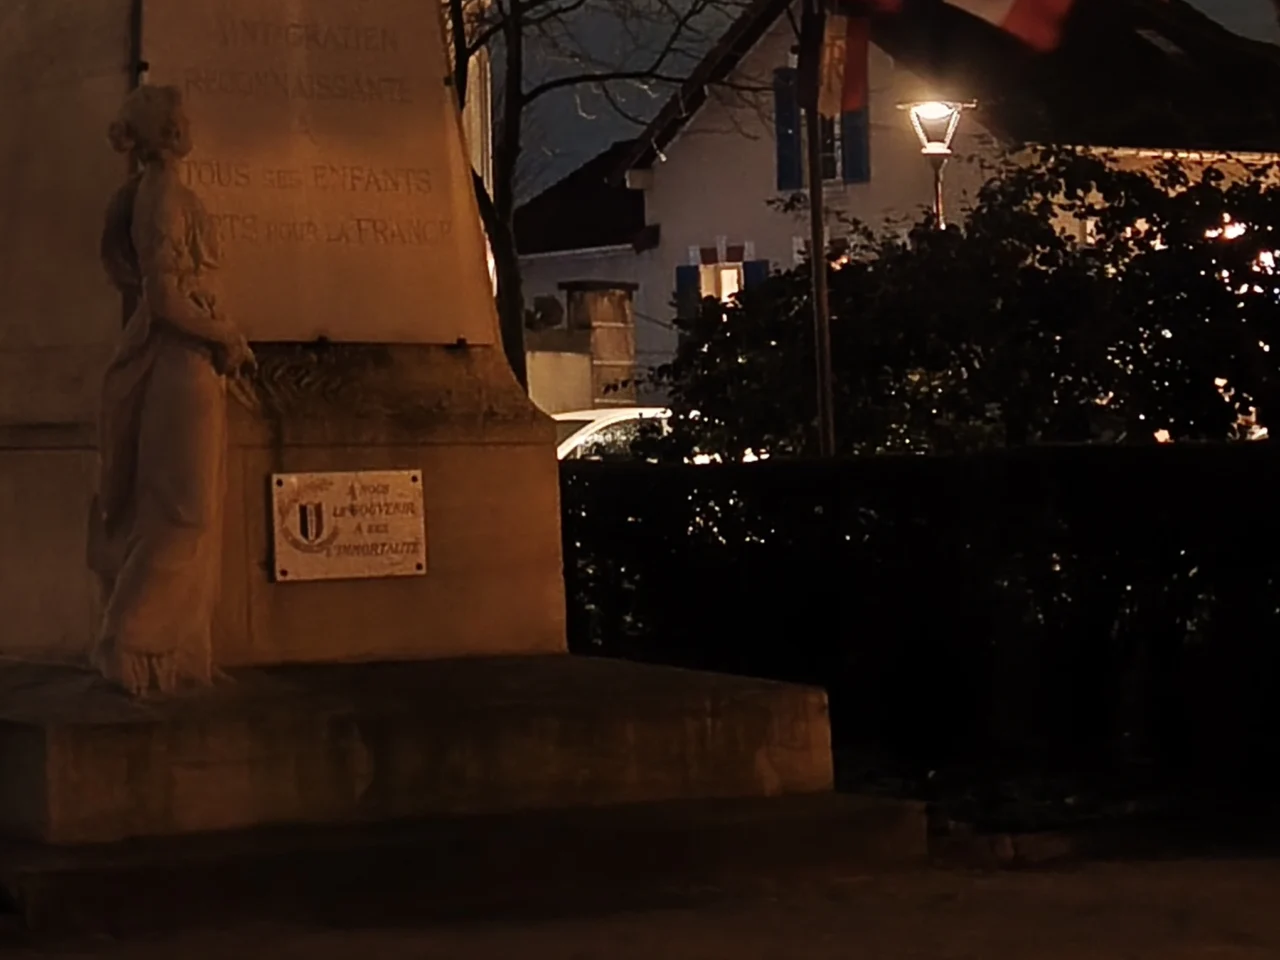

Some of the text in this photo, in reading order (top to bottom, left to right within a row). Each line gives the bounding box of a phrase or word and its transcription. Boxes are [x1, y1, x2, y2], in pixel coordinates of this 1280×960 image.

[182, 160, 433, 194] TOUS SES ENFANTS
[267, 220, 319, 243] POUR
[326, 222, 351, 245] LA
[354, 217, 453, 246] FRANCE
[348, 502, 416, 517] SOUVENIR
